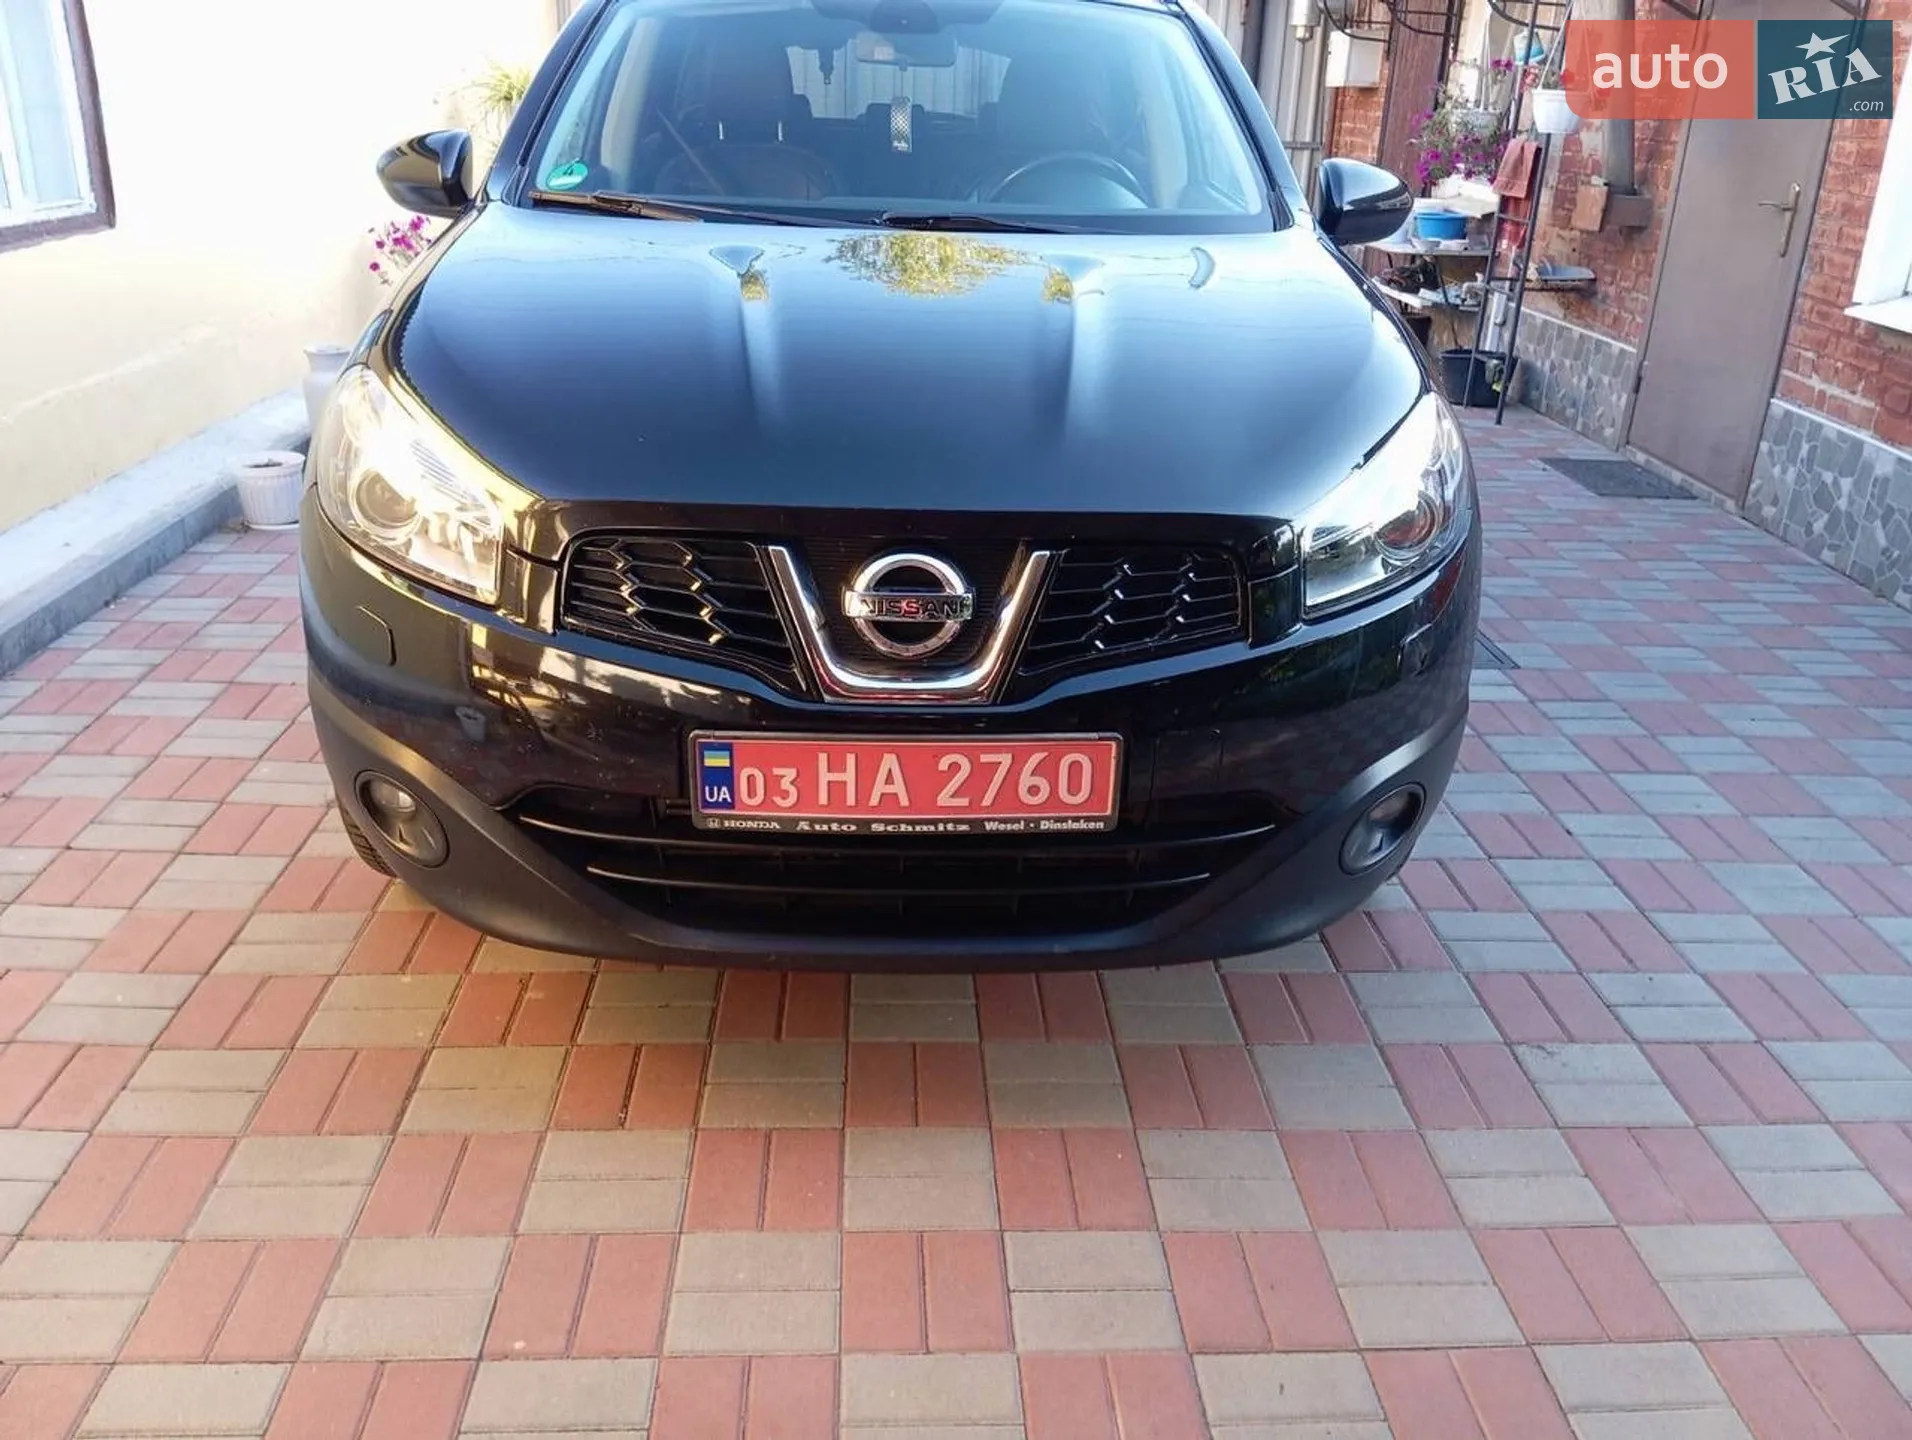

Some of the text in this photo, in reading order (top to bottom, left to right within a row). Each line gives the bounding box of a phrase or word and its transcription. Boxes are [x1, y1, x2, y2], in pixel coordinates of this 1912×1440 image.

[861, 598, 961, 616] NISSAN
[739, 751, 1093, 807] 03 HA 2760
[705, 786, 732, 803] UA
[723, 819, 1105, 832] HONDA Auto Schmitz Wesel Dinslaken
